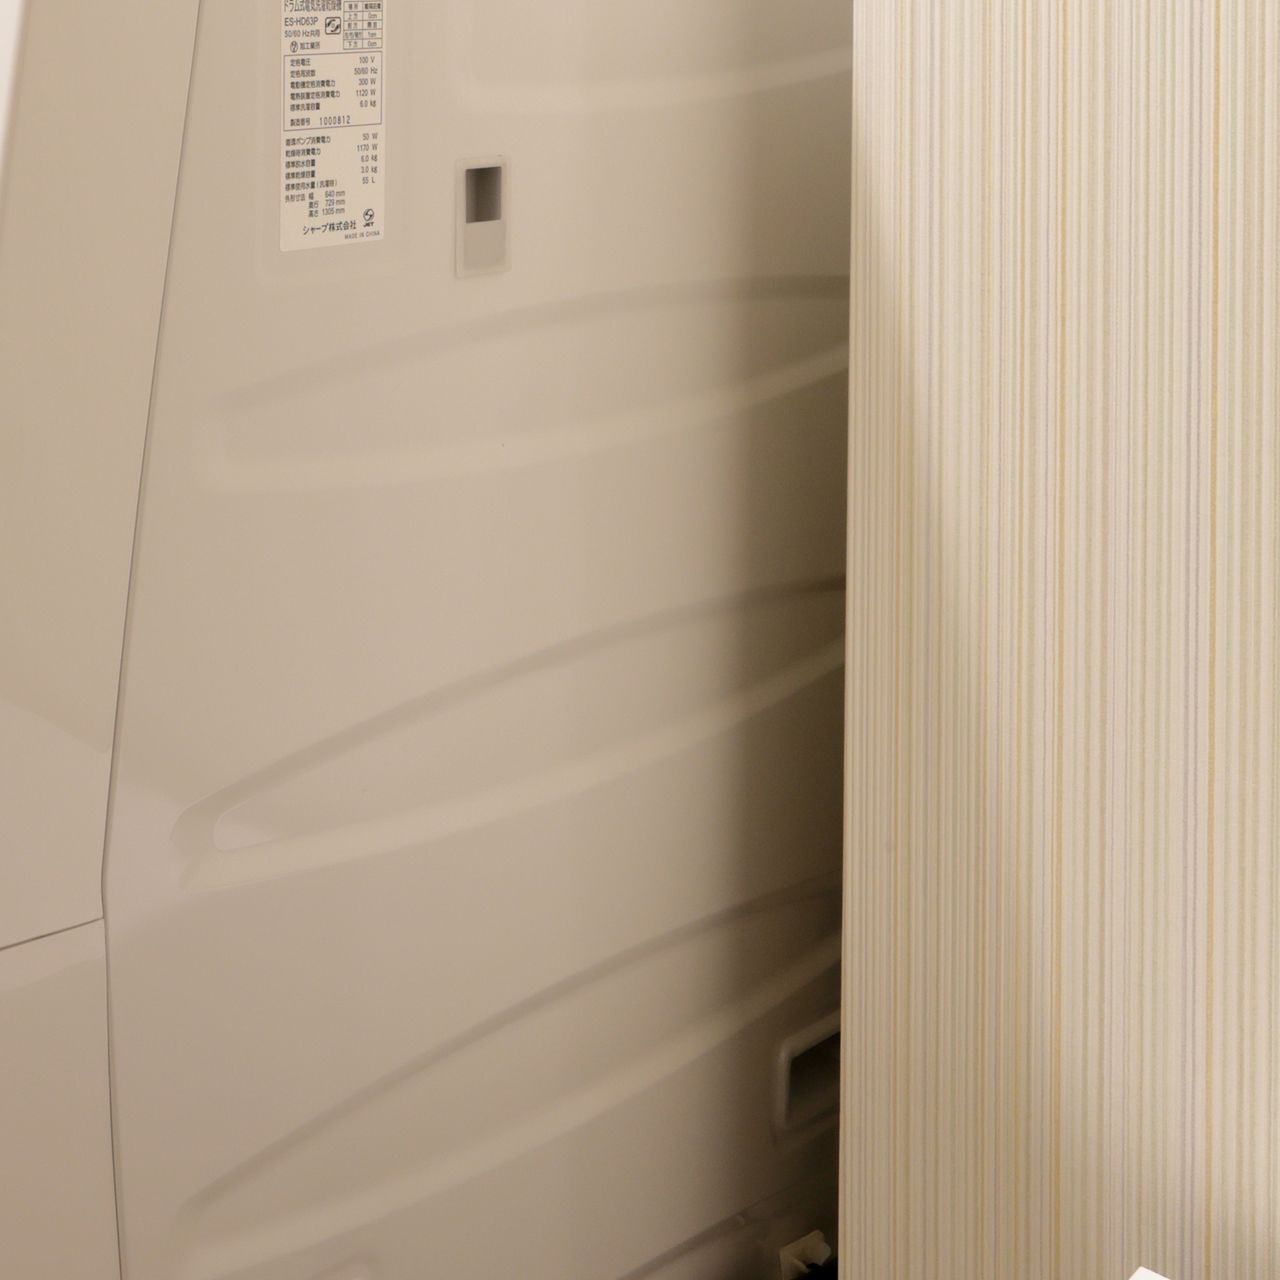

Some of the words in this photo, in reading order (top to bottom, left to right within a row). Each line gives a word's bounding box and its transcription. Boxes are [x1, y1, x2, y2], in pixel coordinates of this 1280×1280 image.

[285, 17, 319, 27] ES-HD63P
[370, 77, 376, 85] W
[303, 219, 357, 236] シャープ株式会社
